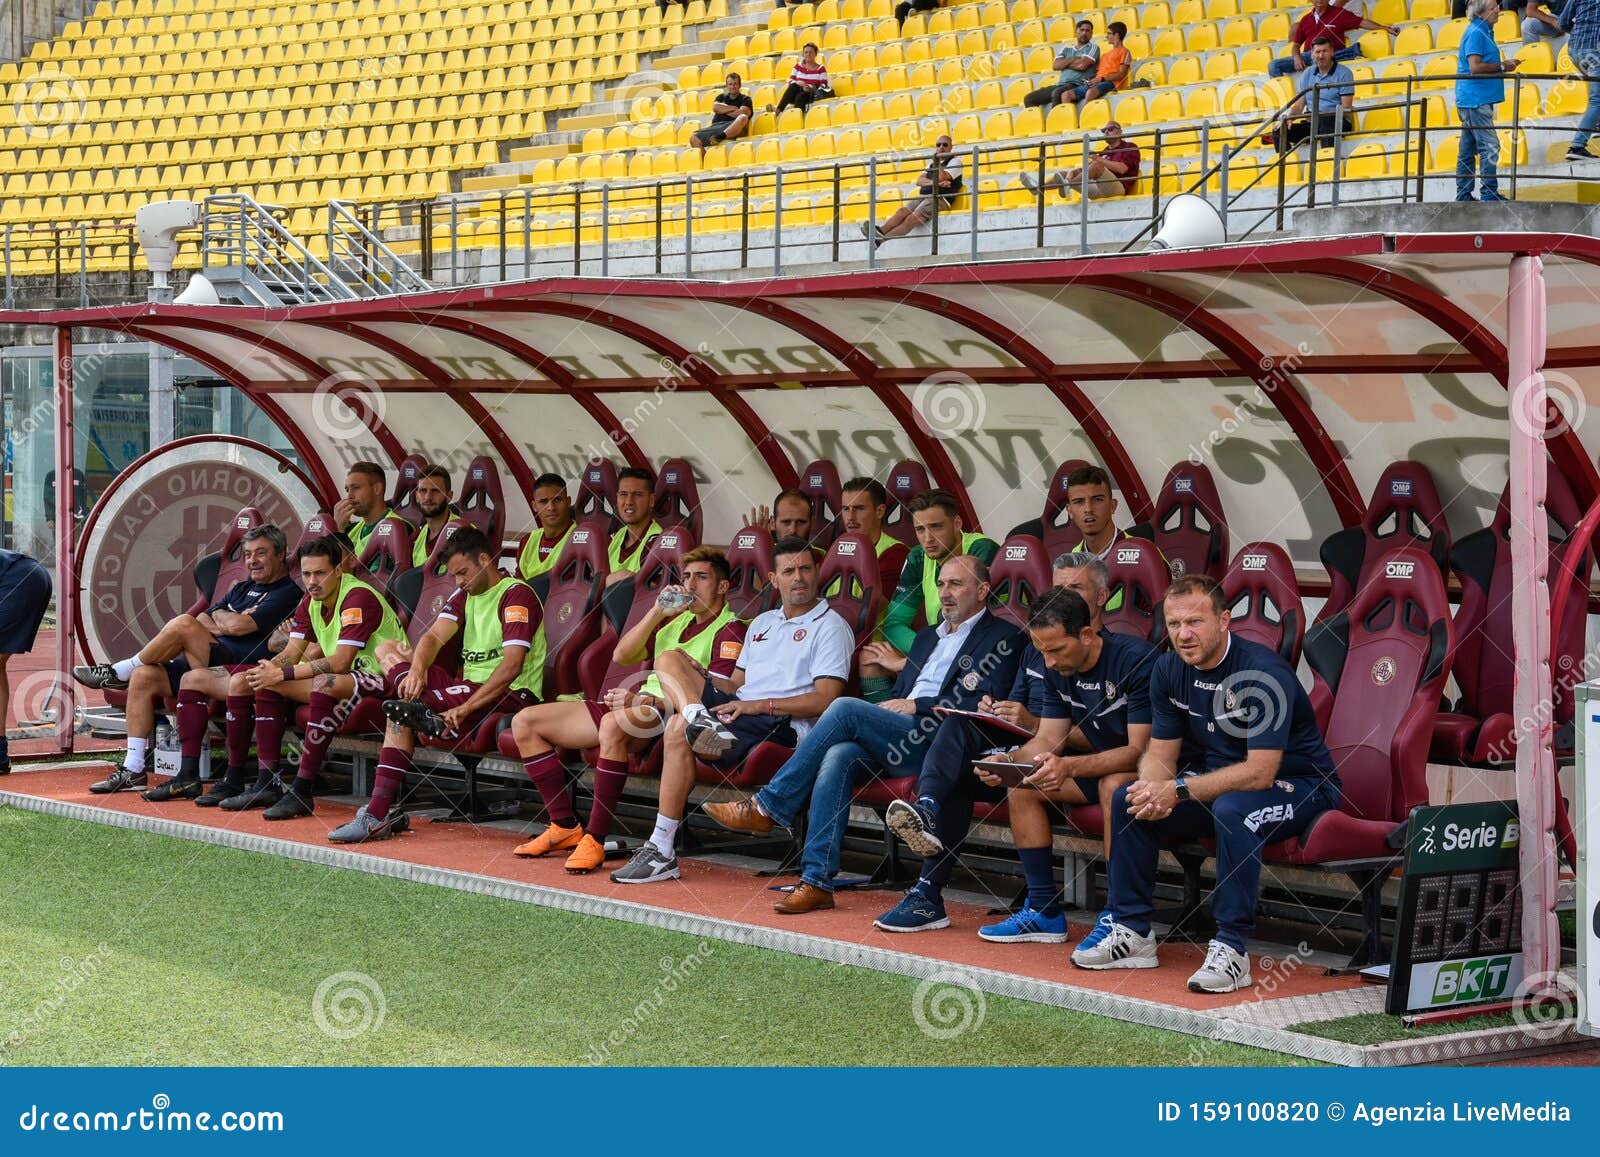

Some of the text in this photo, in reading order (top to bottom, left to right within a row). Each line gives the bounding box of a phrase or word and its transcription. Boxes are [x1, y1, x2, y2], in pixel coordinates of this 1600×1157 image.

[1392, 483, 1410, 493] OMP
[378, 525, 391, 534] OMP
[573, 533, 589, 542] OMP
[661, 537, 678, 547] OMP
[738, 537, 755, 547] OMP
[838, 543, 856, 553] OMP
[1006, 549, 1027, 560] OMP
[1117, 551, 1140, 562] OMP
[1242, 557, 1267, 569] OMP
[1386, 564, 1414, 576] OMP
[1442, 822, 1521, 851] Serie B
[1434, 963, 1509, 998] BKT
